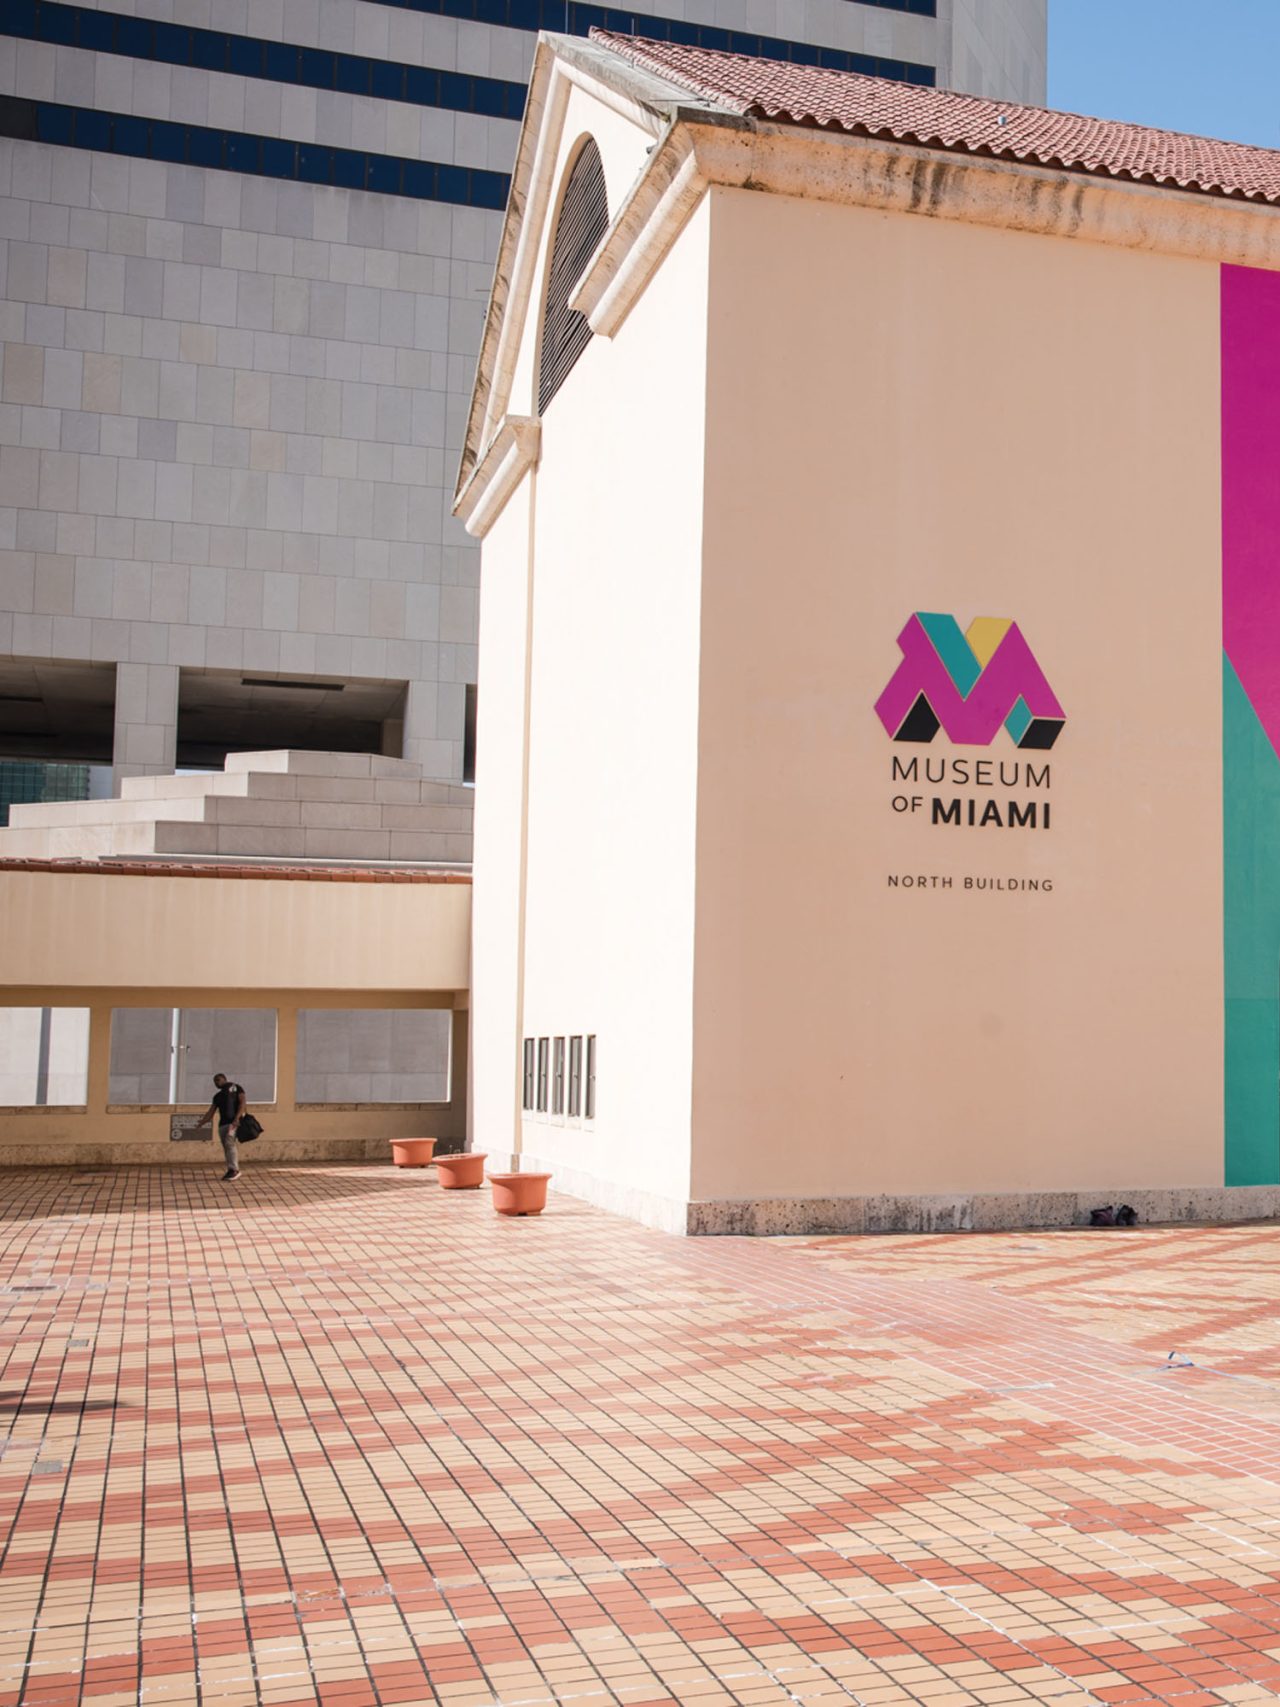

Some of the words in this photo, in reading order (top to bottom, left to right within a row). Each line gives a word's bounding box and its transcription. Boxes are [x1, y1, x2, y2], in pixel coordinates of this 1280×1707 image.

[892, 756, 1050, 789] MUSEUM
[891, 796, 923, 812] OF
[931, 797, 1050, 829] MIAMI
[887, 875, 952, 888] NORTH
[964, 877, 1053, 892] BUILDING
